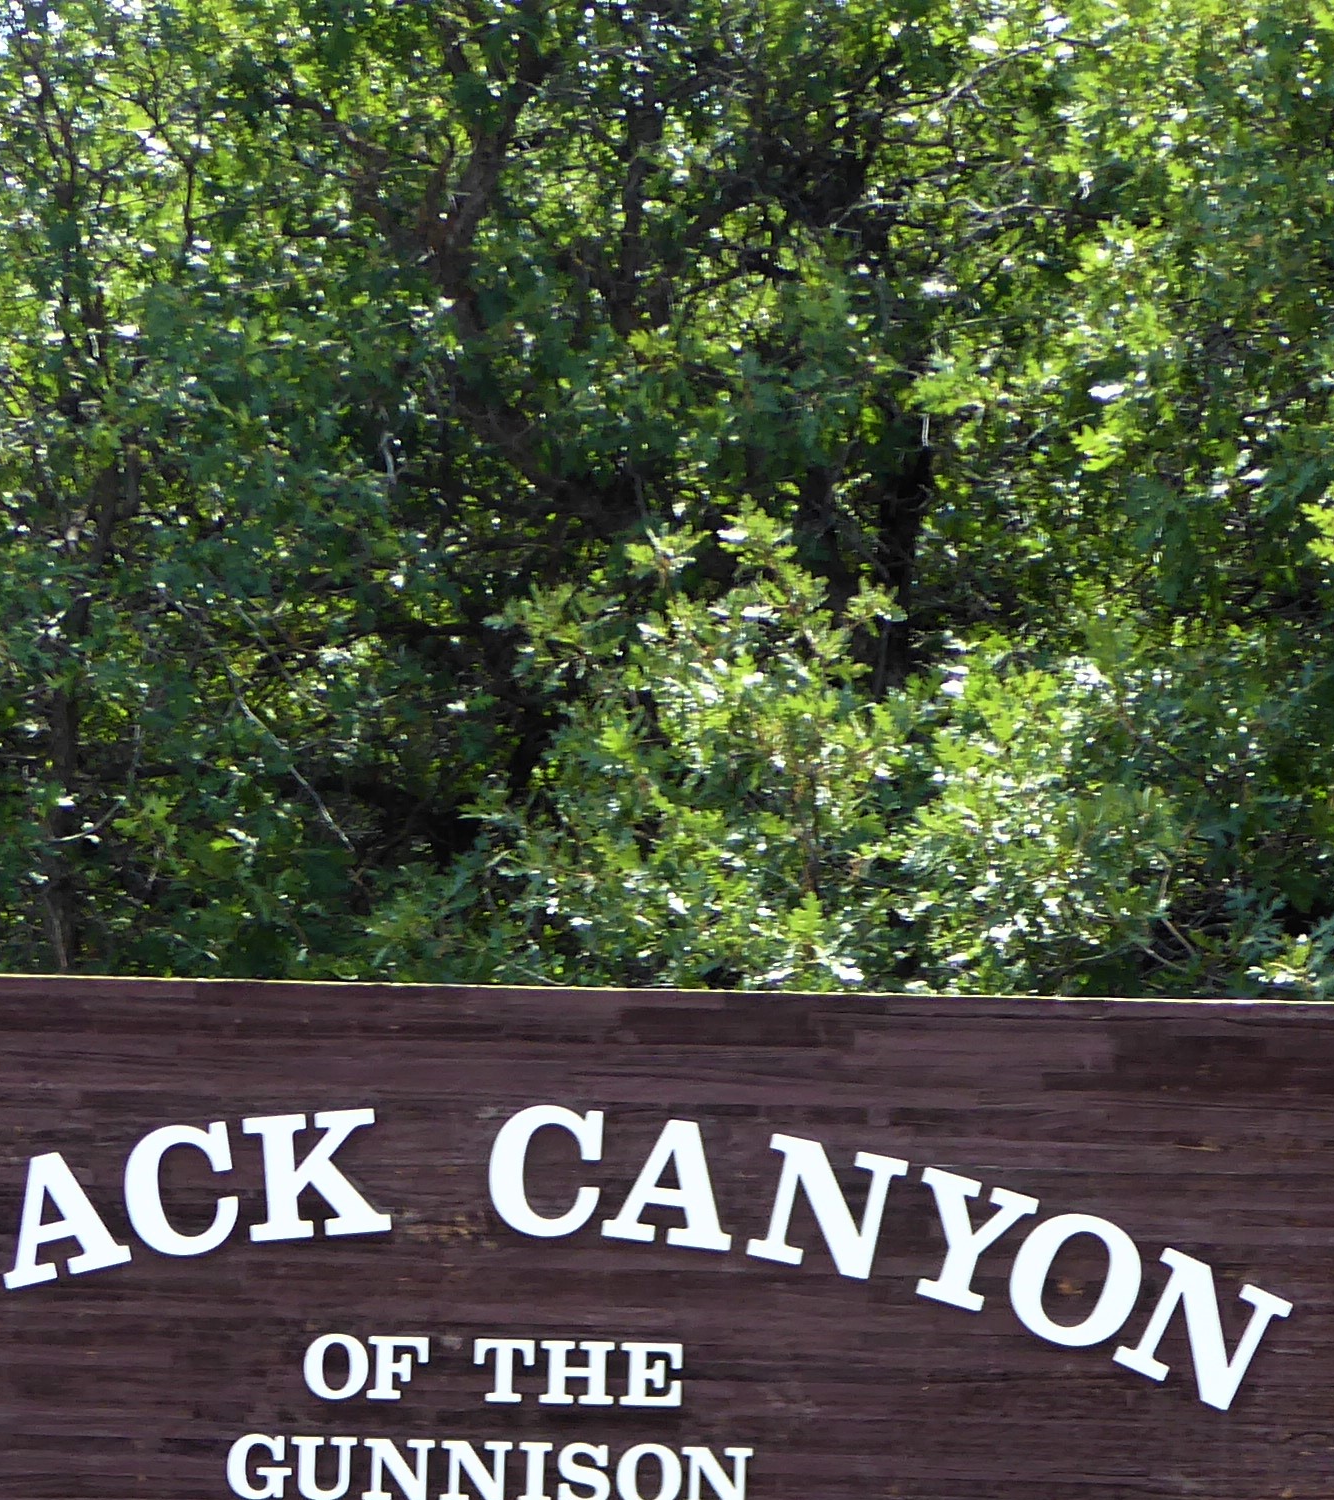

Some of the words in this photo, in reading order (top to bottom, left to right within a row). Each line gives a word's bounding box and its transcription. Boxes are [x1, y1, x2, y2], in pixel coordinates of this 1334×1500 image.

[487, 1104, 1295, 1412] CANYON
[303, 1332, 430, 1401] OF
[473, 1338, 684, 1408] THE
